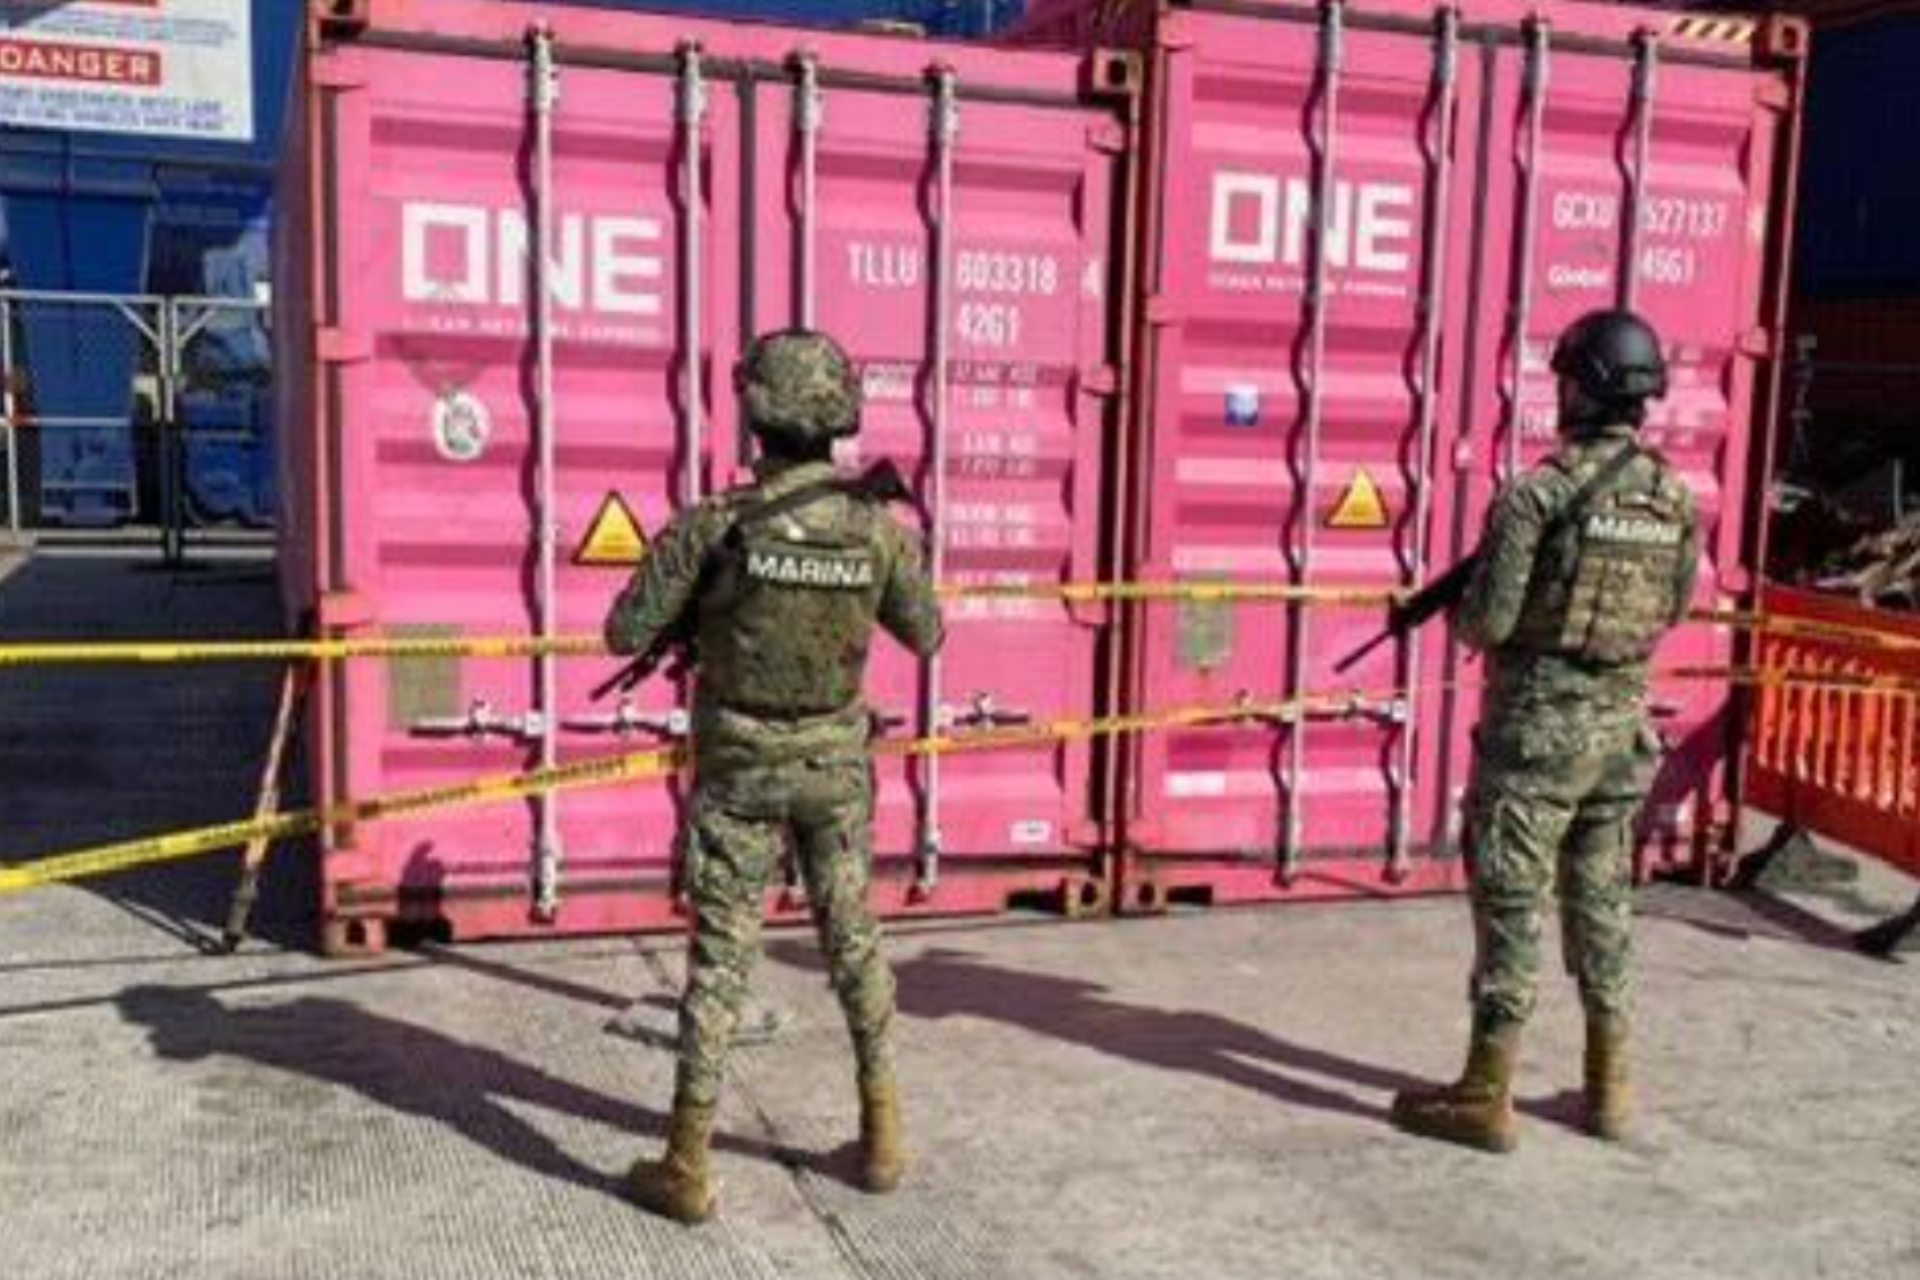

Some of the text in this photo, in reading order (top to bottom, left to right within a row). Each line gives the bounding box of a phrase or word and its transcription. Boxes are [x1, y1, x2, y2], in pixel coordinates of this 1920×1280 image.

[0, 46, 150, 80] DANGER
[1208, 171, 1414, 271] ONE
[402, 202, 664, 315] ONE
[848, 241, 919, 287] TLLU
[745, 552, 874, 585] MARINA
